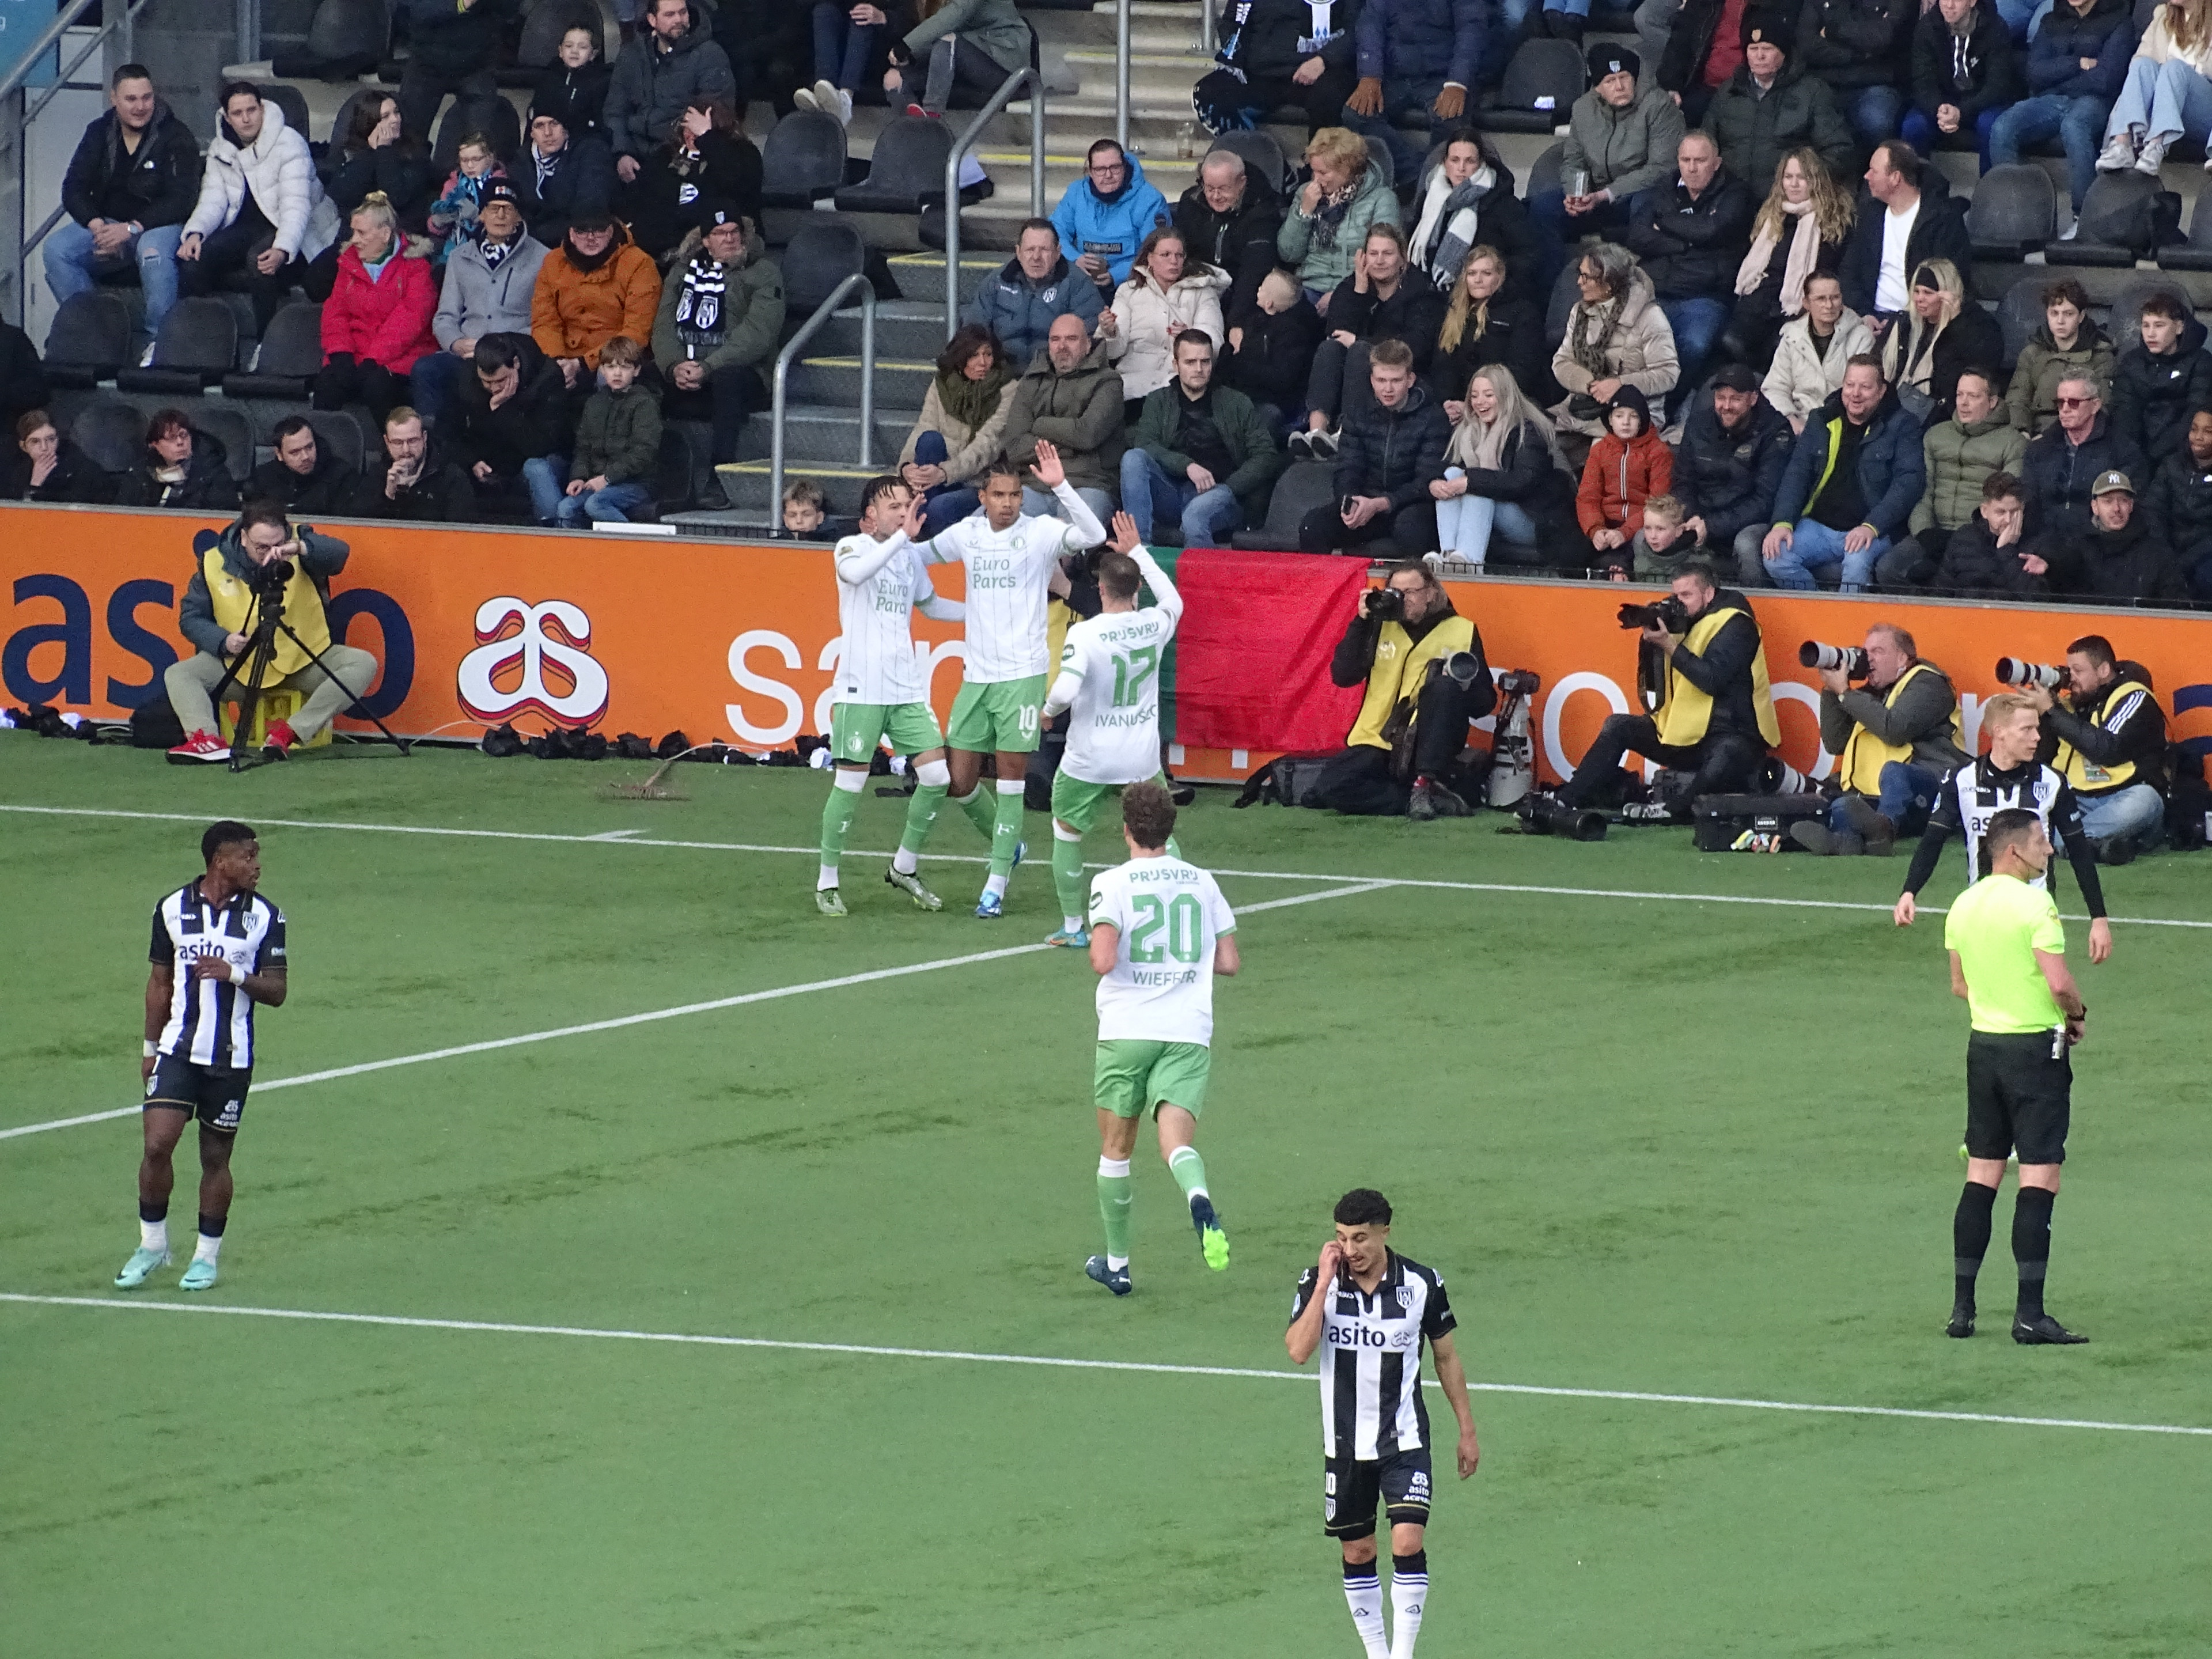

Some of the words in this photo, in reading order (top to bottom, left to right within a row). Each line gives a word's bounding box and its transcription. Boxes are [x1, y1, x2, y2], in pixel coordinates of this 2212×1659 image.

[972, 556, 1010, 571] Euro
[878, 579, 908, 597] Euro
[972, 574, 1016, 589] Parcs
[2, 528, 415, 720] aso
[1111, 644, 1157, 707] 17
[1018, 704, 1037, 731] 10
[1129, 868, 1198, 884] PRIJSVRIJ
[1130, 893, 1203, 964] 20
[179, 938, 225, 961] asito
[1328, 1321, 1386, 1347] asito
[1408, 1485, 1429, 1497] asito
